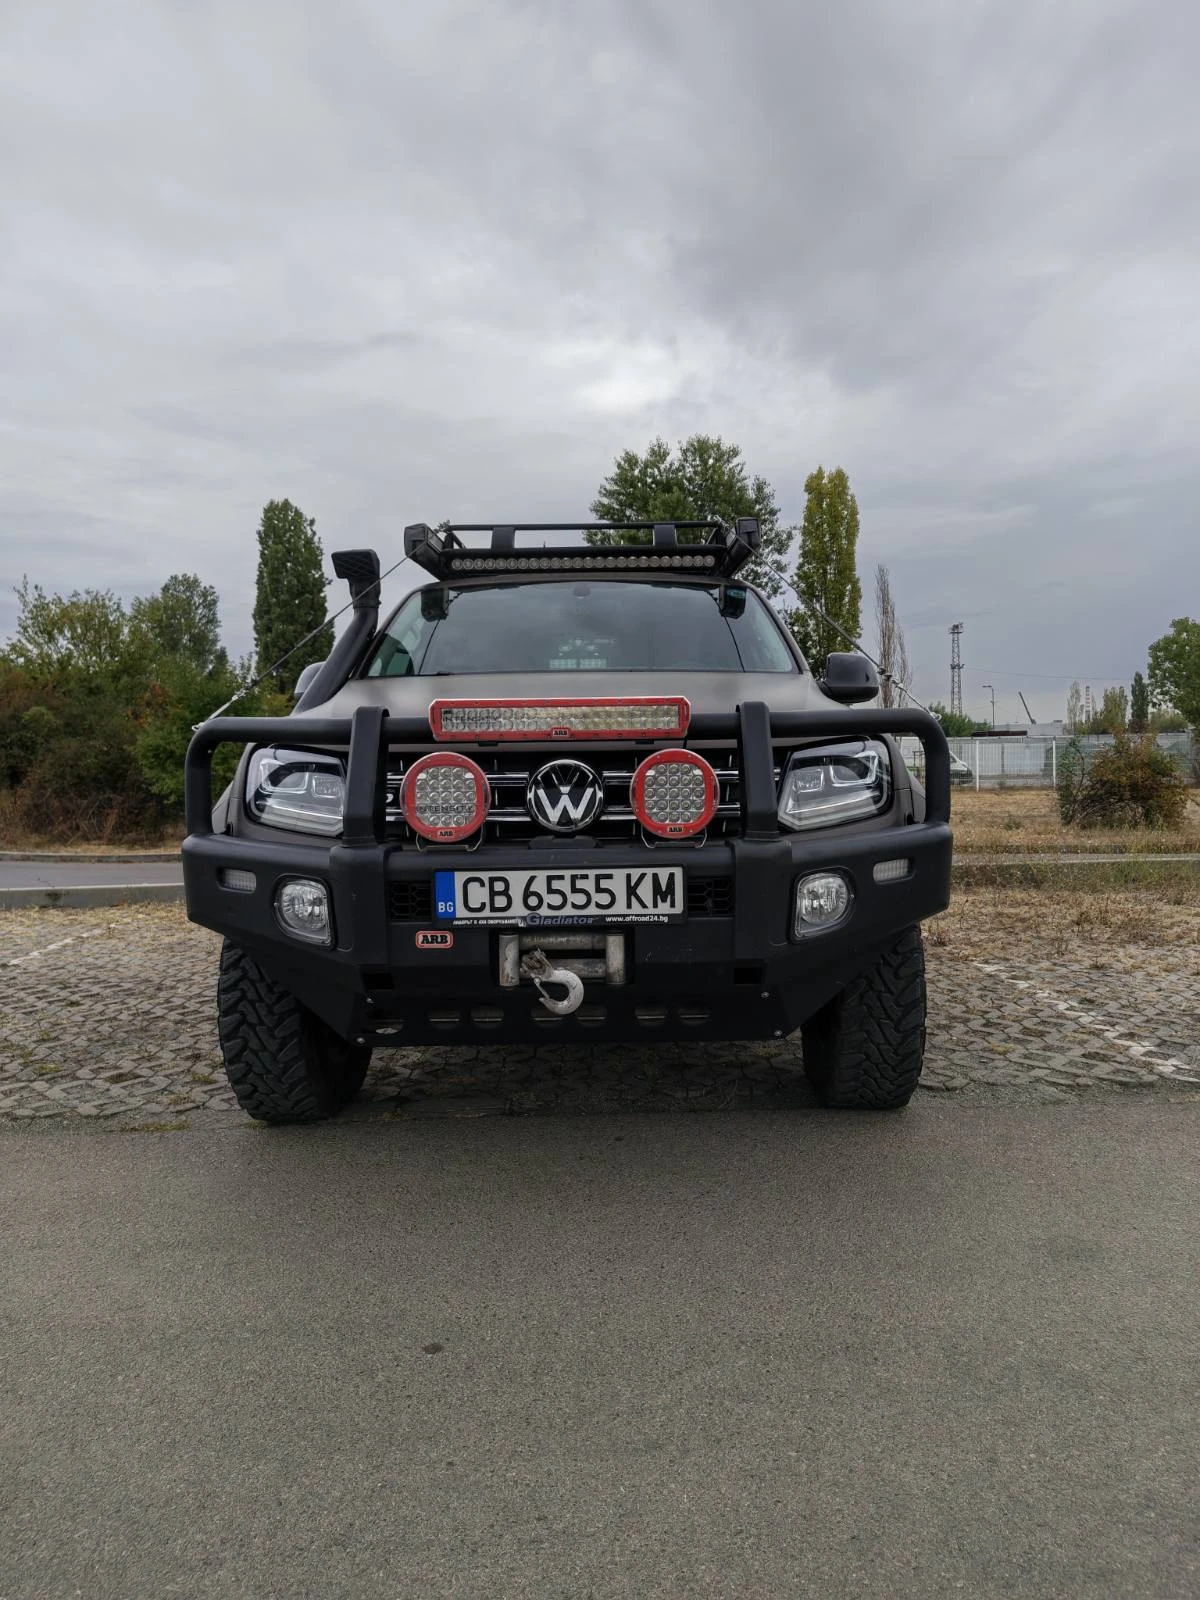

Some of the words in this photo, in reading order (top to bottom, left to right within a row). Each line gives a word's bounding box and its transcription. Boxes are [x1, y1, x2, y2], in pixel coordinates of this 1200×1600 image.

[462, 875, 513, 914] CB
[522, 873, 617, 912] 6555
[625, 871, 676, 910] KM
[438, 902, 455, 913] BG
[526, 912, 594, 925] Gladiator
[605, 915, 669, 923] www.offroad24.bg
[420, 934, 449, 945] ARB
